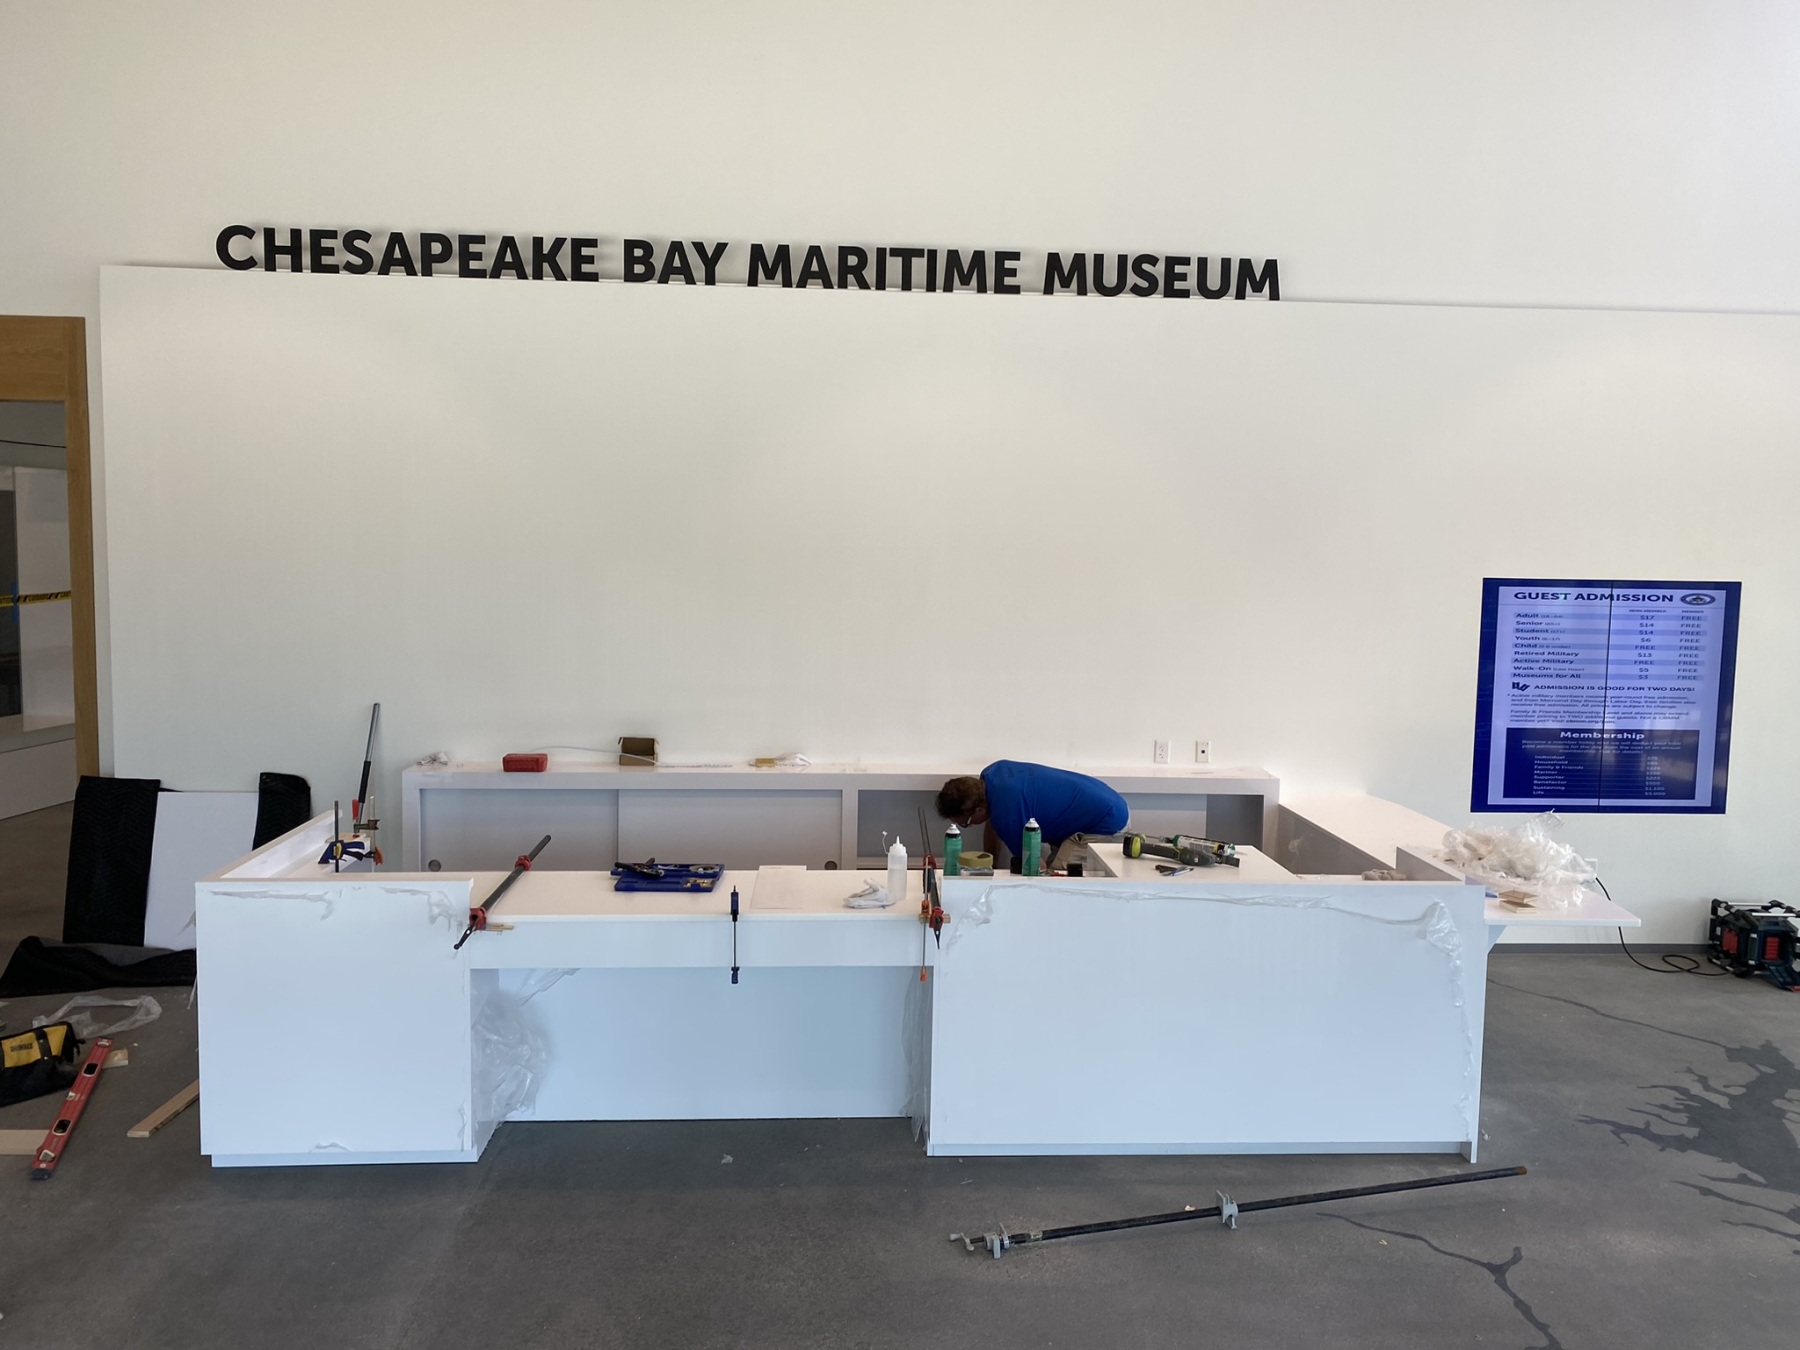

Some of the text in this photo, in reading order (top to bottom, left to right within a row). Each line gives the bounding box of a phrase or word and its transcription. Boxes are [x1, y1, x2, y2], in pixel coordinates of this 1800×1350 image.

[216, 224, 1281, 301] CHESAPEAKE BAY MARITIME MUSEUM
[1513, 591, 1572, 601] GUEST
[1573, 592, 1674, 603] ADMISSION
[1560, 731, 1645, 740] Membership
